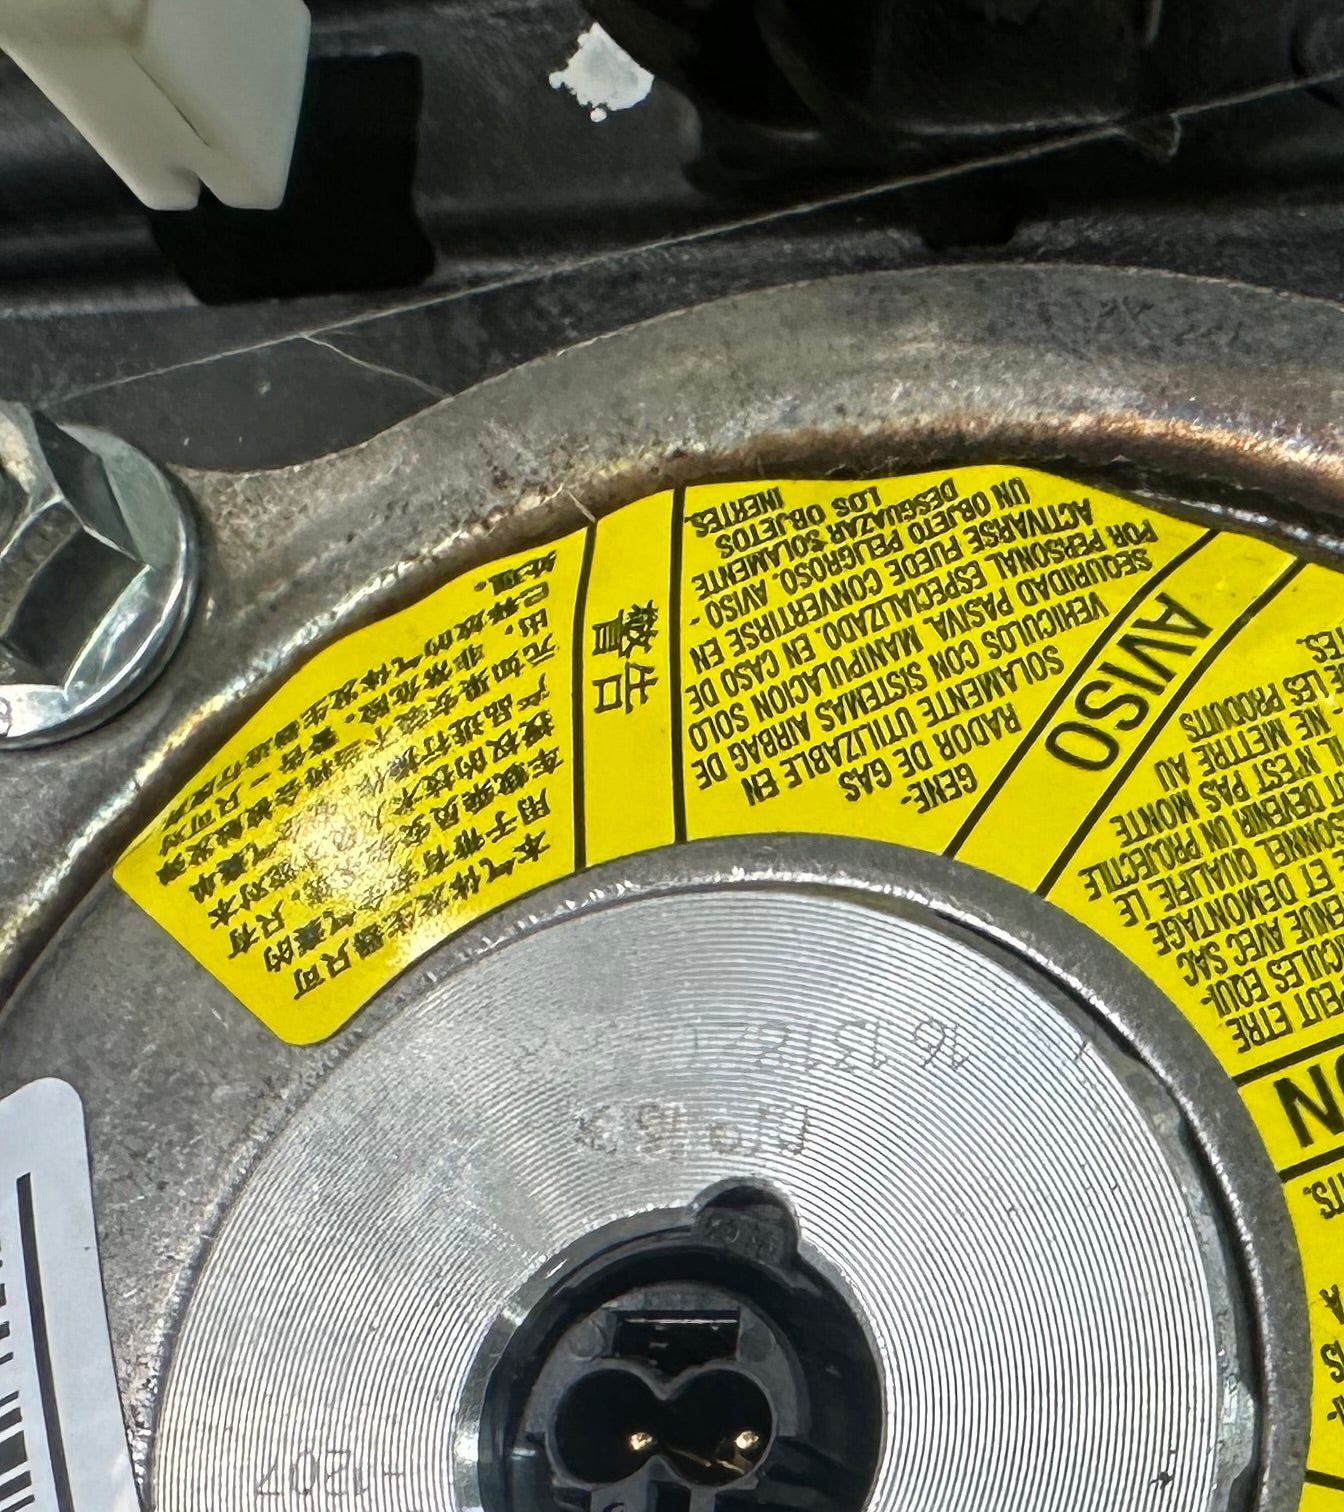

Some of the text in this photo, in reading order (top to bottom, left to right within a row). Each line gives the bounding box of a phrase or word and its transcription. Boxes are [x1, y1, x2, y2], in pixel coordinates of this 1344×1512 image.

[714, 486, 882, 559] LOS OBJETOS
[904, 491, 991, 545] OBJETO
[1105, 519, 1159, 548] POR
[983, 528, 1107, 580] PERSONAL
[704, 578, 768, 629] AVISO
[724, 567, 884, 658] CONVERTIRSE
[688, 624, 924, 752] MANIPULACION SOLO
[720, 649, 780, 698] CASO
[727, 591, 1110, 772] VEHICULOS CON SISTEMAS AIRBAG
[1044, 592, 1209, 771] AVISO
[1282, 669, 1329, 707] LES
[779, 644, 1065, 789] SOLAMENTE UTILIZABLE
[1178, 682, 1286, 744] PRODUITS
[838, 702, 1023, 802] RADOR GAS
[1191, 718, 1292, 777] METTRE
[900, 762, 978, 815] GENE-
[1198, 769, 1251, 814] PAS
[1232, 781, 1326, 839] DEVENIR
[1109, 789, 1200, 848] MONTE
[1077, 827, 1202, 902] PROJECTILE
[1144, 872, 1299, 956] DEMONTAGE
[1225, 916, 1286, 967] AVEC
[1175, 941, 1229, 987] SAC
[1200, 967, 1269, 1019] EQUI-
[1225, 1001, 1294, 1054] ETRE
